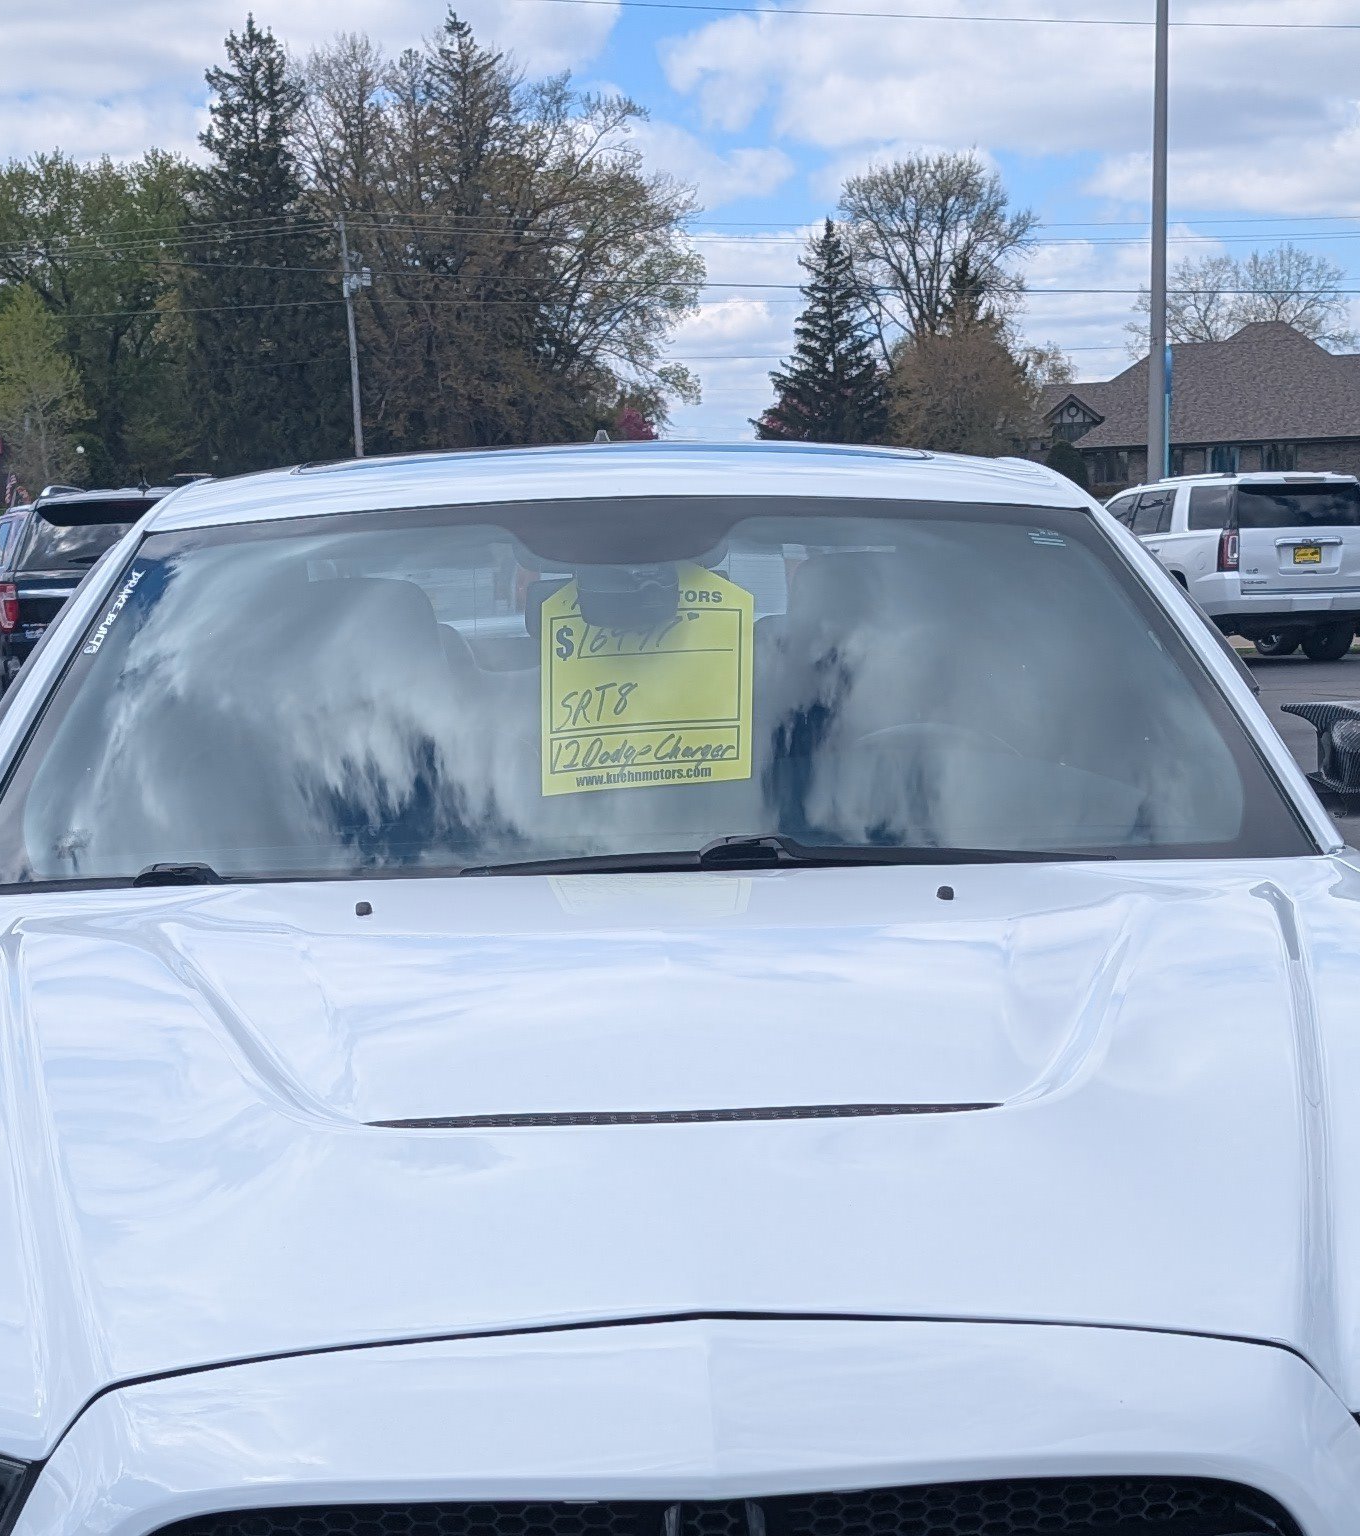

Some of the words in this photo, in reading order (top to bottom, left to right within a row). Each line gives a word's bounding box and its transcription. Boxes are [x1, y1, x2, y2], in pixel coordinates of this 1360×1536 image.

[554, 681, 639, 731] SRT8
[653, 733, 737, 769] Charger
[575, 765, 713, 788] www.kuehnmotors.com
